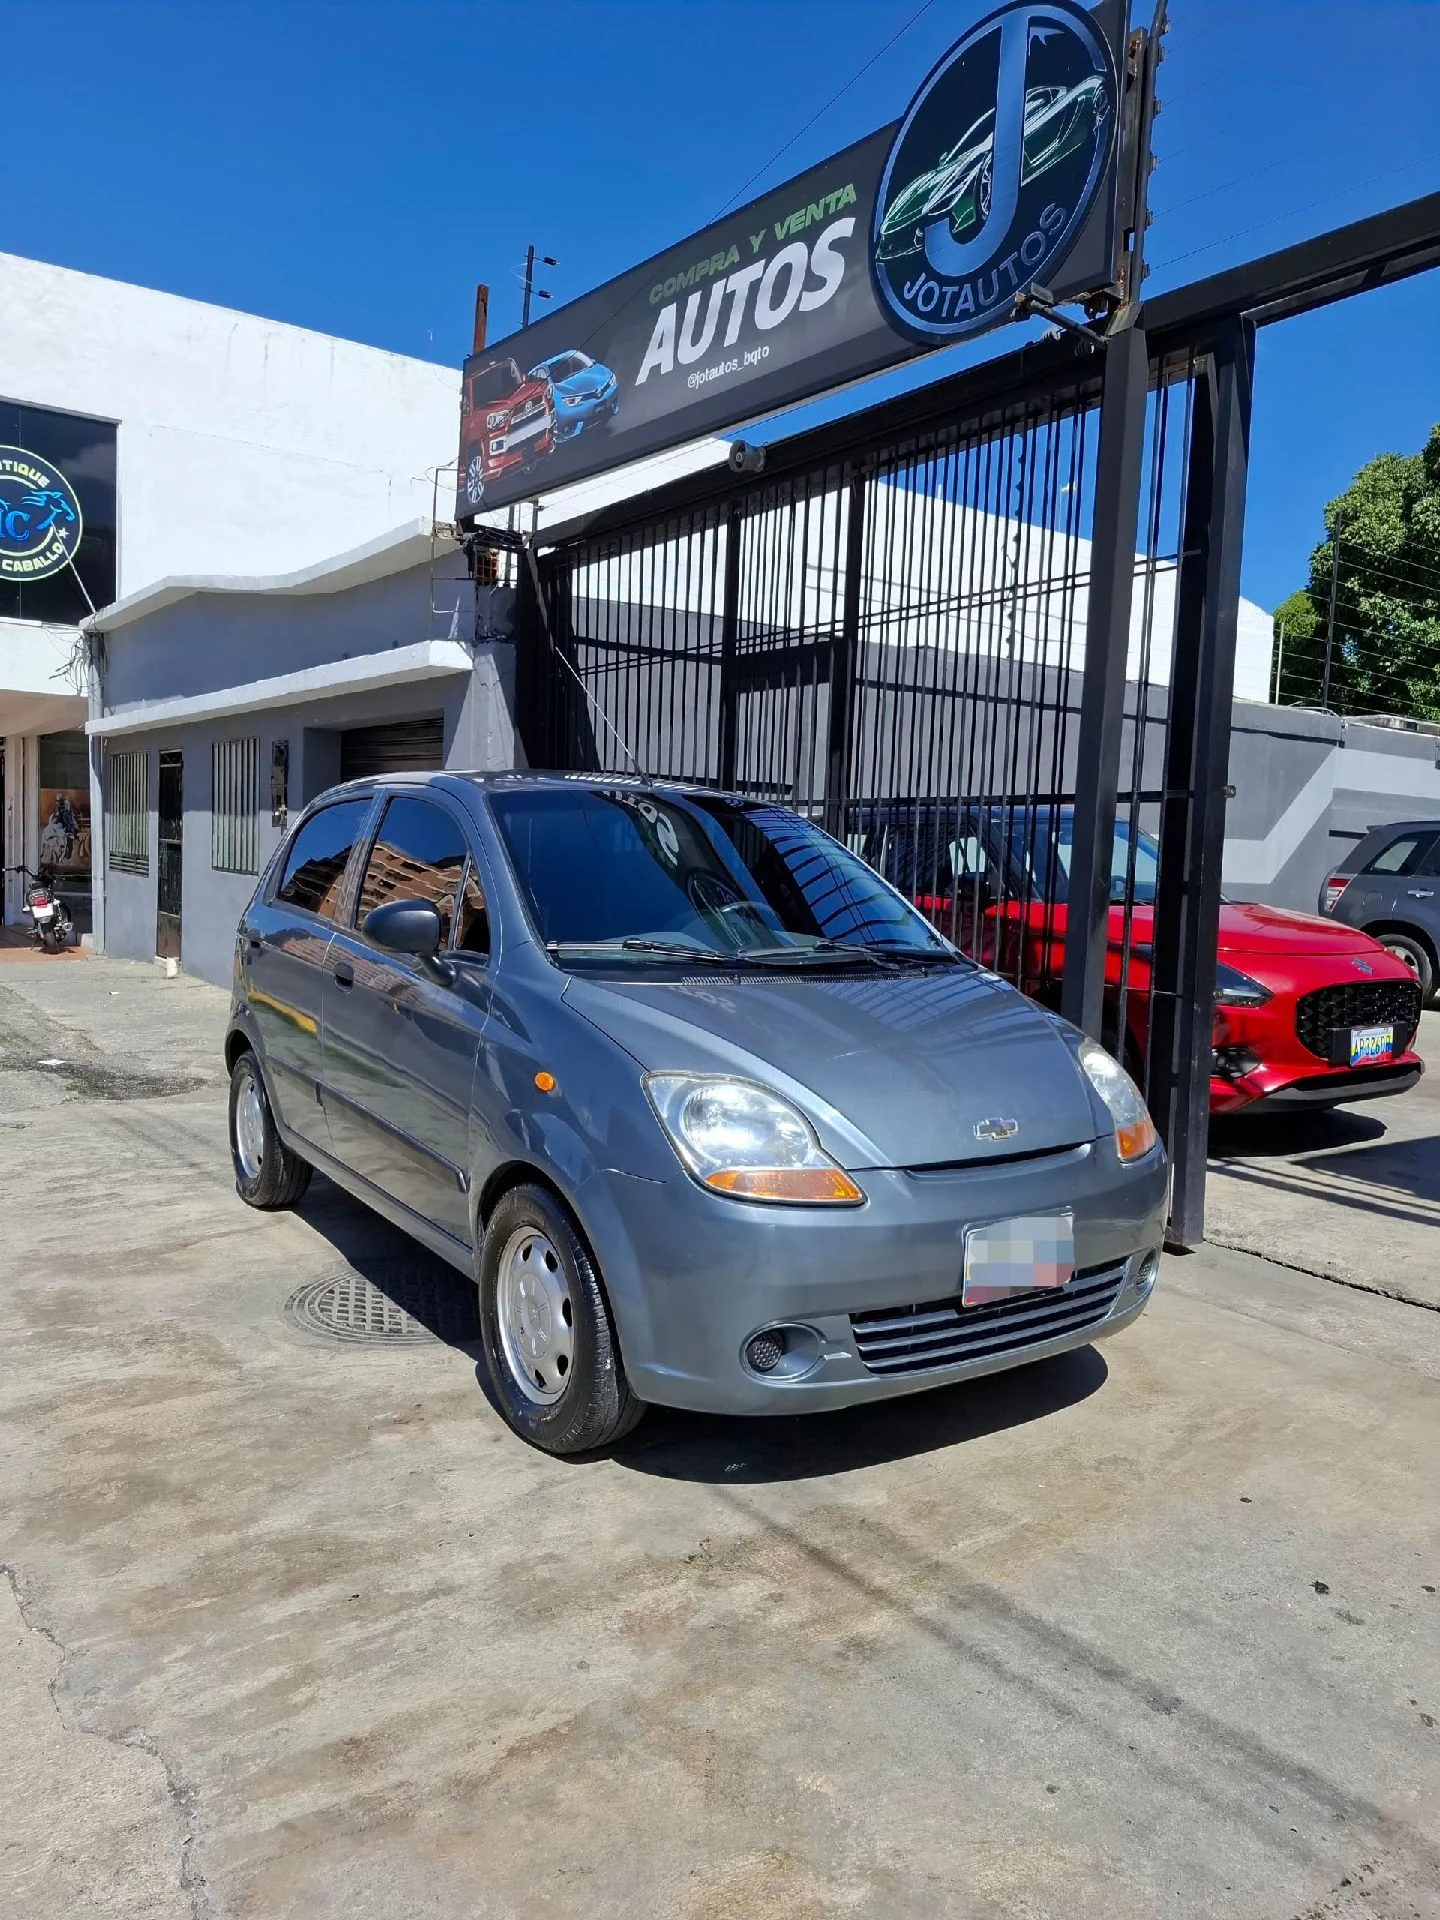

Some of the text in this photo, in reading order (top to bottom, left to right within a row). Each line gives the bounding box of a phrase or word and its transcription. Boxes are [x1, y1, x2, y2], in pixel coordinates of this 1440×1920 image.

[650, 183, 857, 305] COMPRA Y VENTA
[903, 202, 1067, 318] JOTAUTOS
[635, 217, 856, 386] AUTOS
[687, 345, 770, 390] @jotautos_bqto
[0, 459, 50, 488] TIQUE
[2, 542, 63, 573] CABALLO
